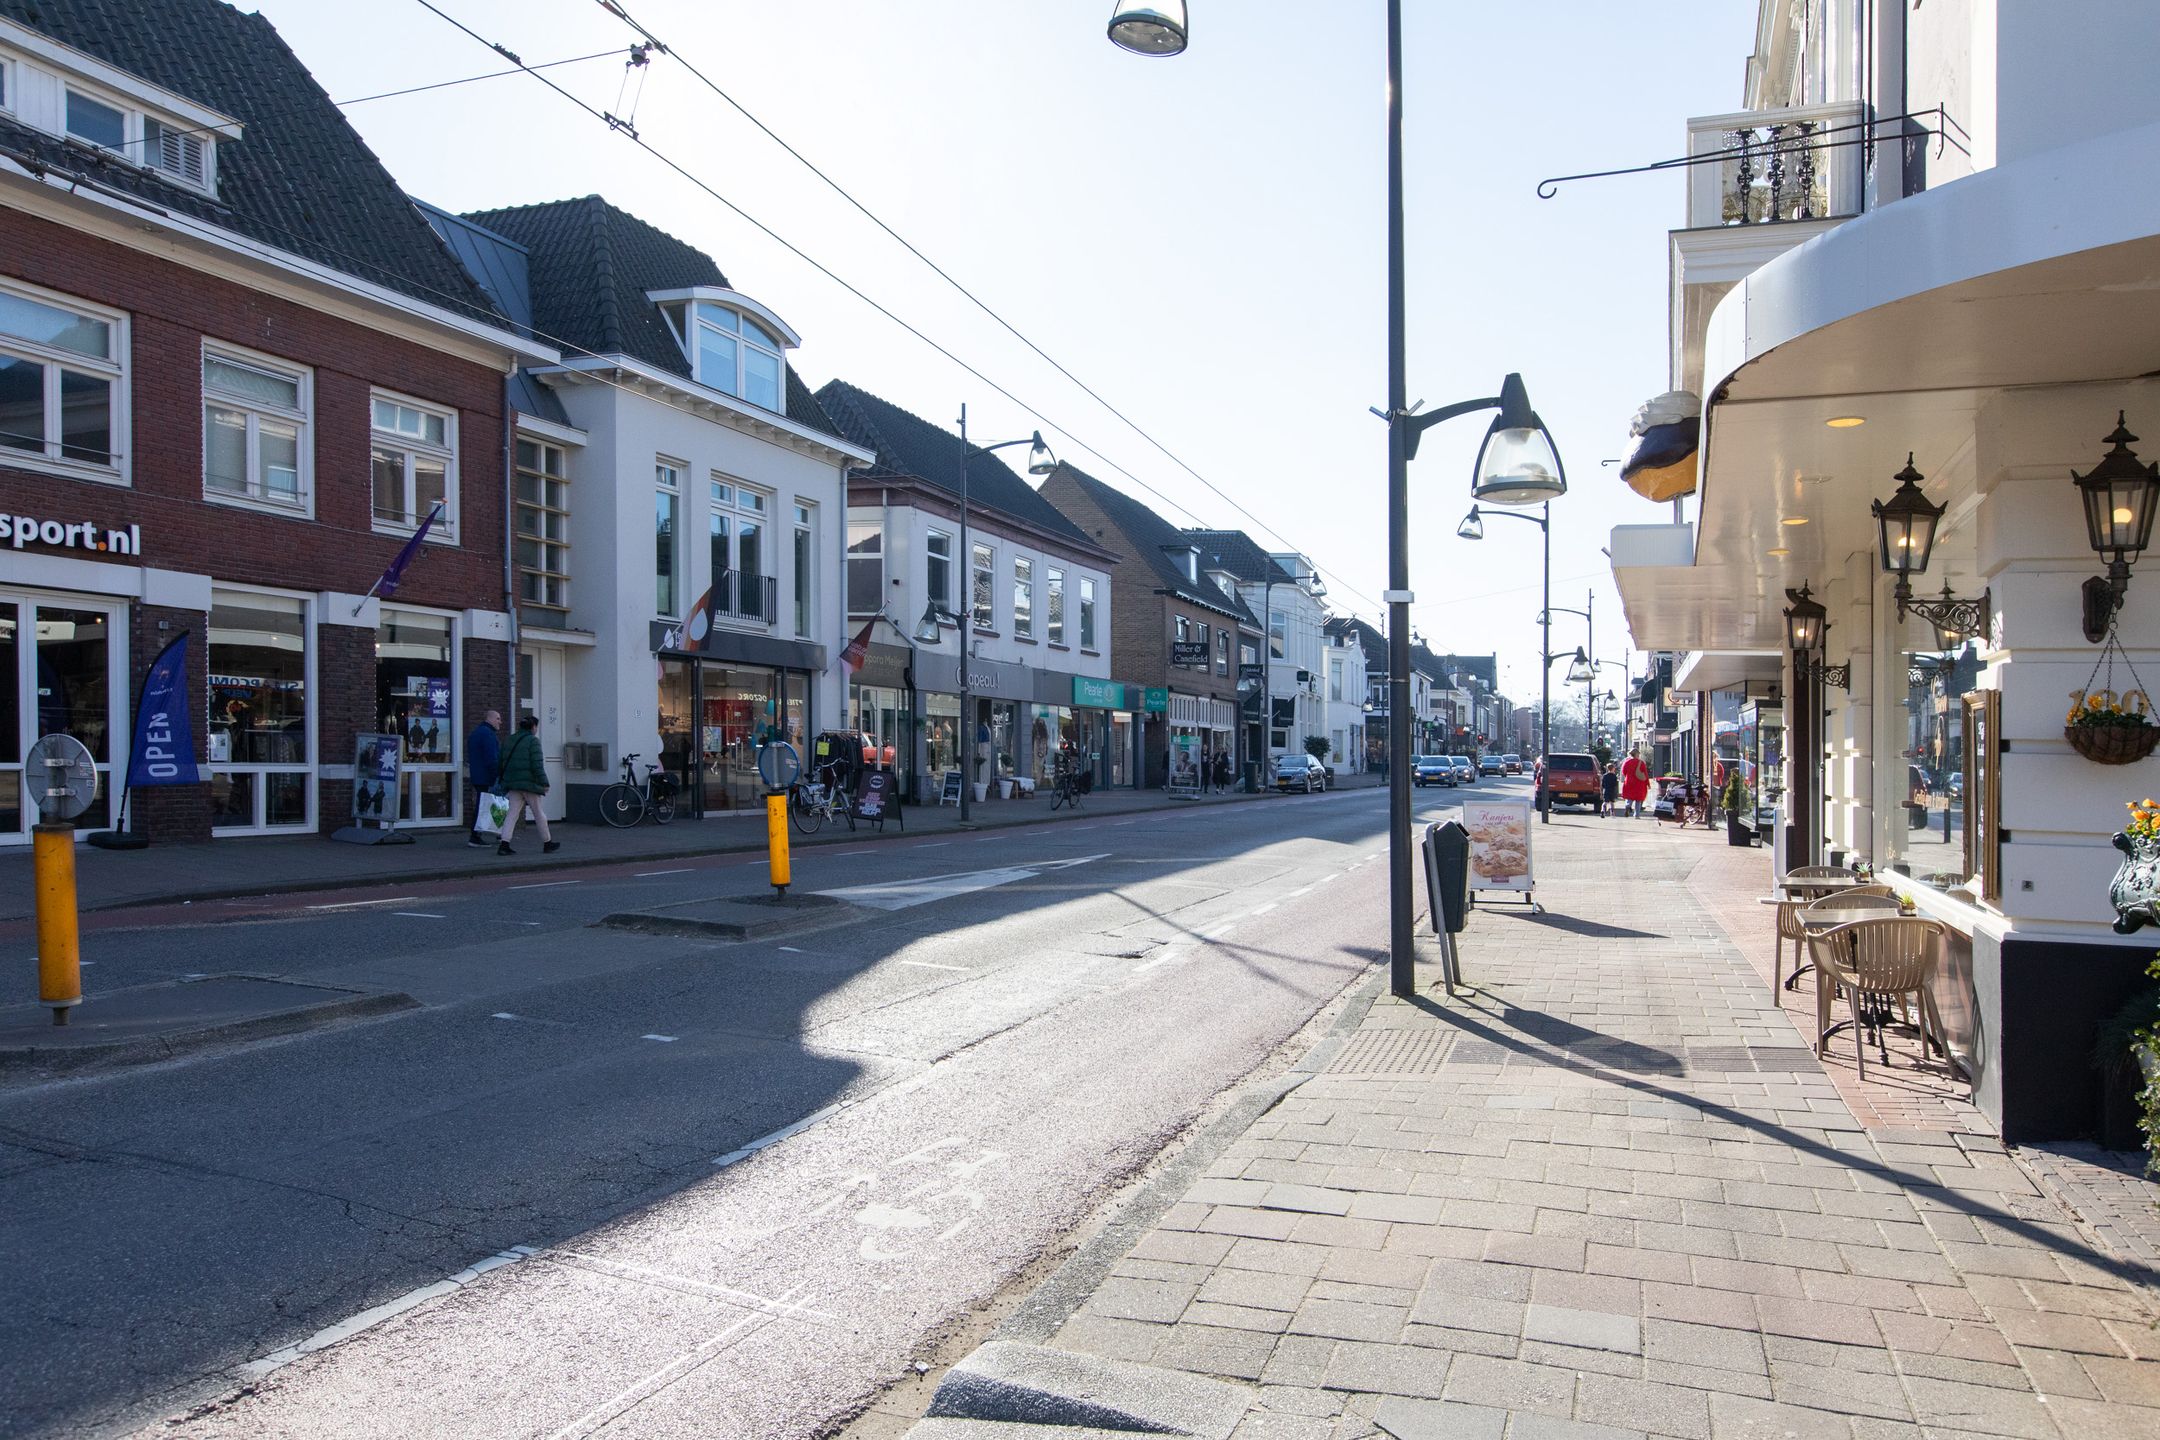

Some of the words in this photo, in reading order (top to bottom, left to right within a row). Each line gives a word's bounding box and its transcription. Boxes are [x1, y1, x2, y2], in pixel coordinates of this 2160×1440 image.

[1175, 644, 1193, 653] Miller
[1084, 681, 1103, 697] Pearle
[145, 712, 178, 778] OPEN
[1480, 809, 1515, 823] Kanjers
